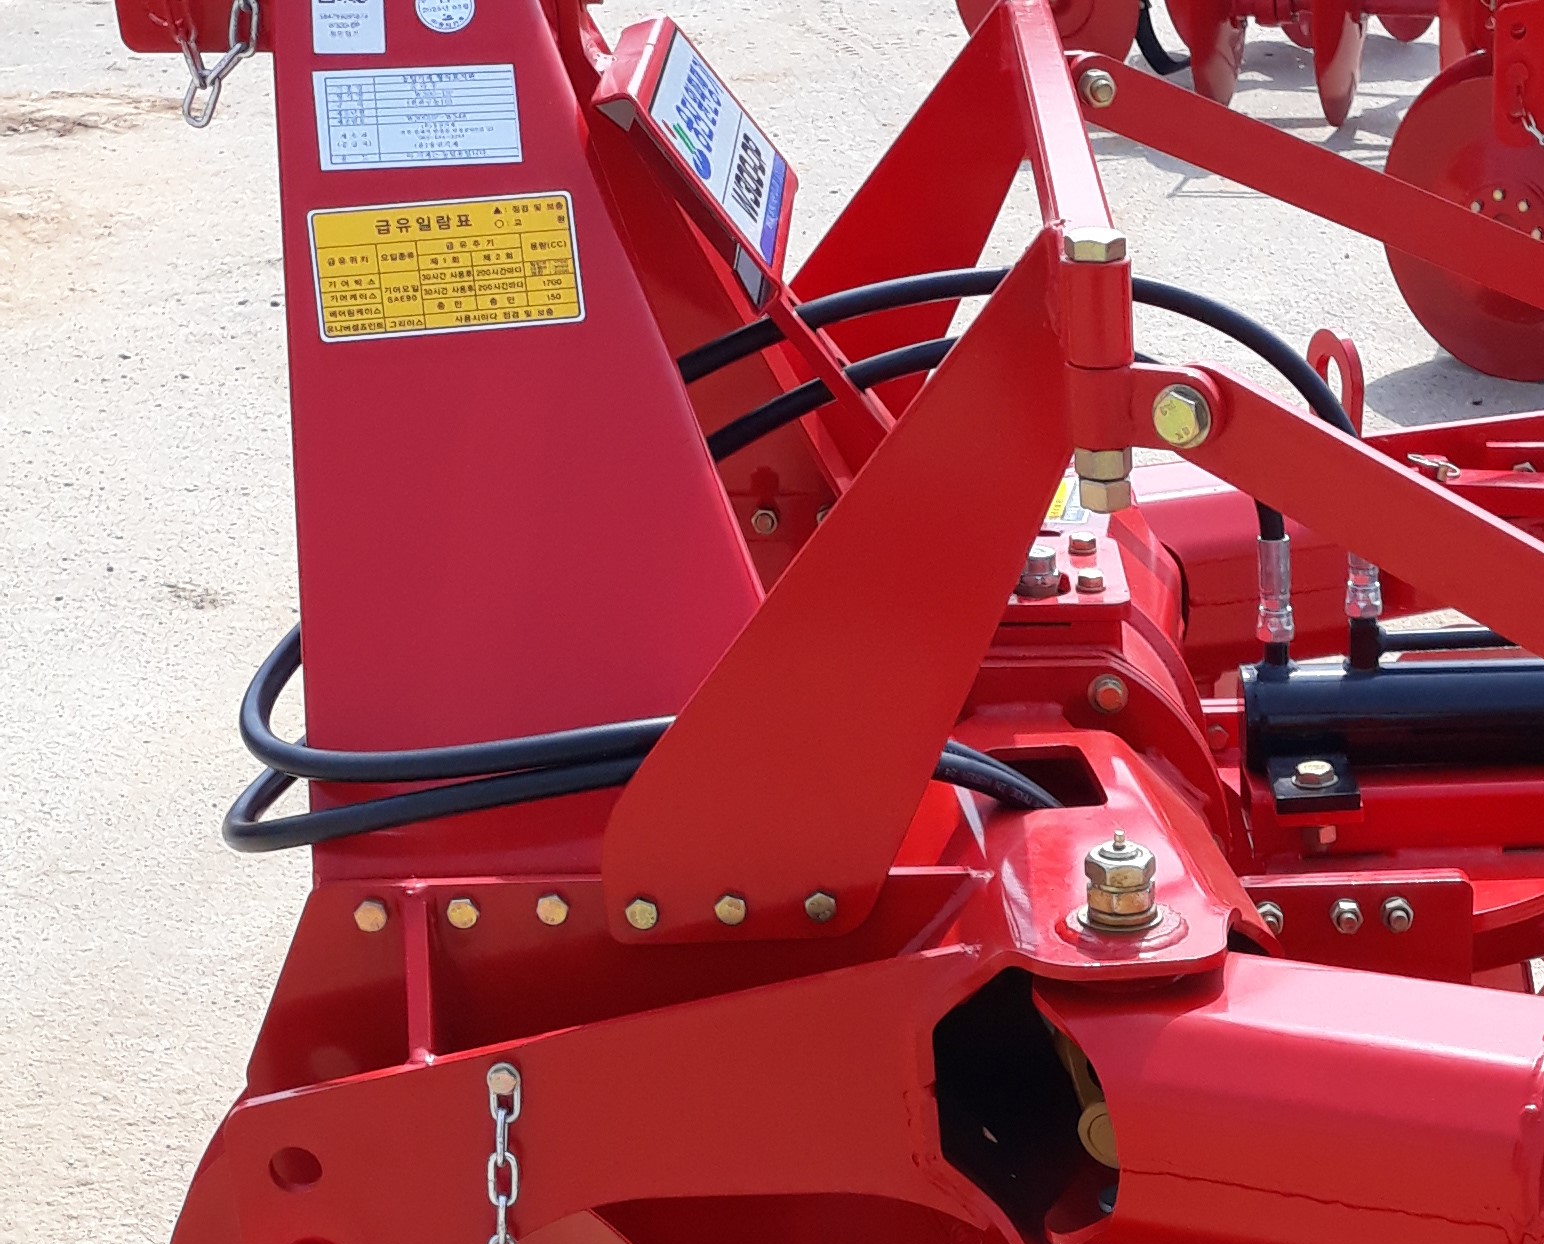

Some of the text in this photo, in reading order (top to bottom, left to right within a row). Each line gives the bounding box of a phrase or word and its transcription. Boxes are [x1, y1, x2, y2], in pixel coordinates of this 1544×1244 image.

[731, 133, 768, 223] W300-DP
[375, 214, 472, 235] 급유일람표
[384, 285, 419, 295] 기어오일
[547, 292, 561, 301] 150
